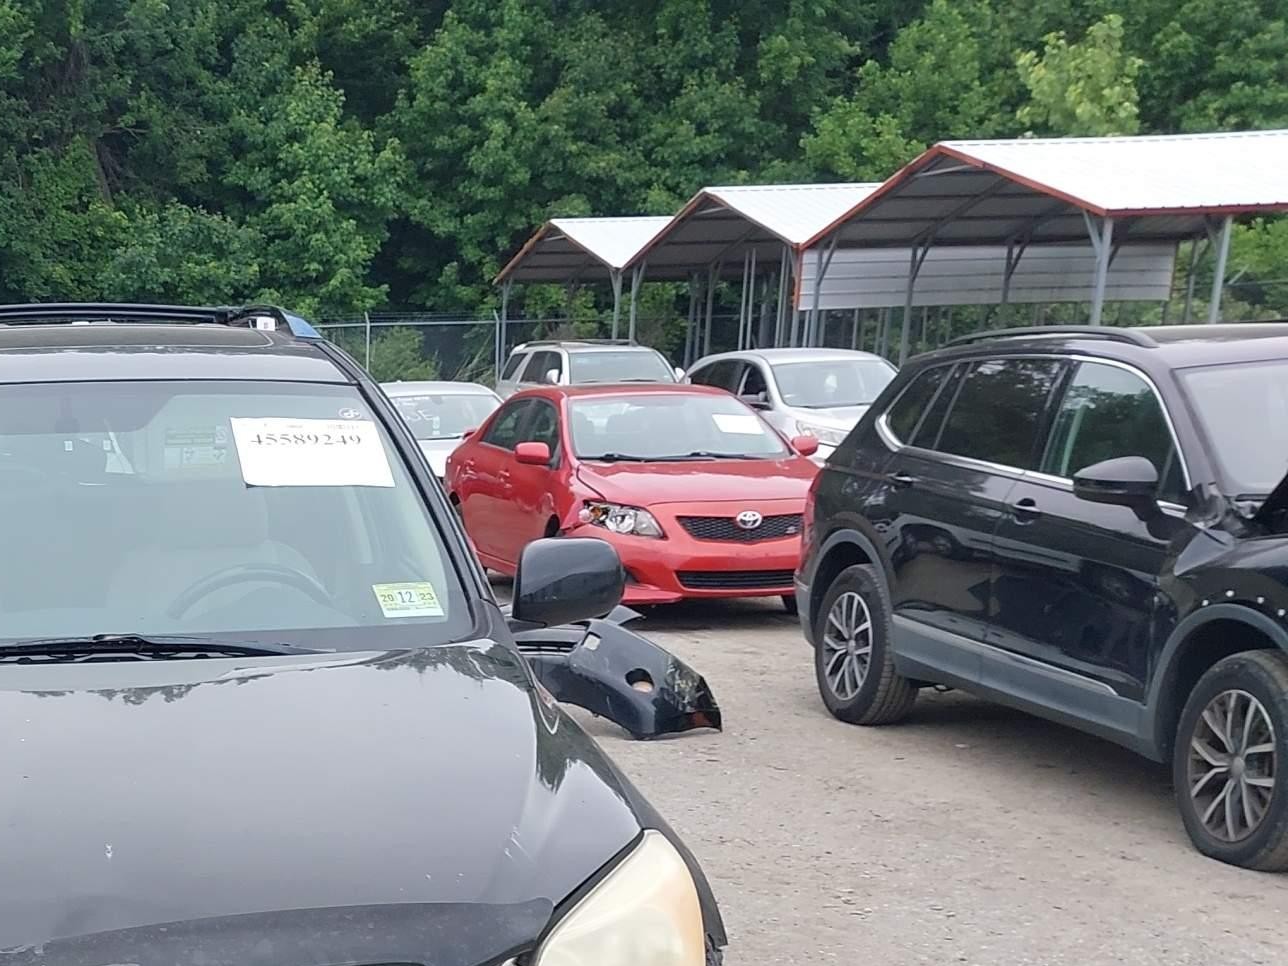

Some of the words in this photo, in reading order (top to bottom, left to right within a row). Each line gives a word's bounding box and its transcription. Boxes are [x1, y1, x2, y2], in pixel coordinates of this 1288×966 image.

[250, 433, 361, 446] 45589249
[379, 593, 395, 603] 20
[398, 590, 416, 603] 12
[419, 592, 434, 601] 23
